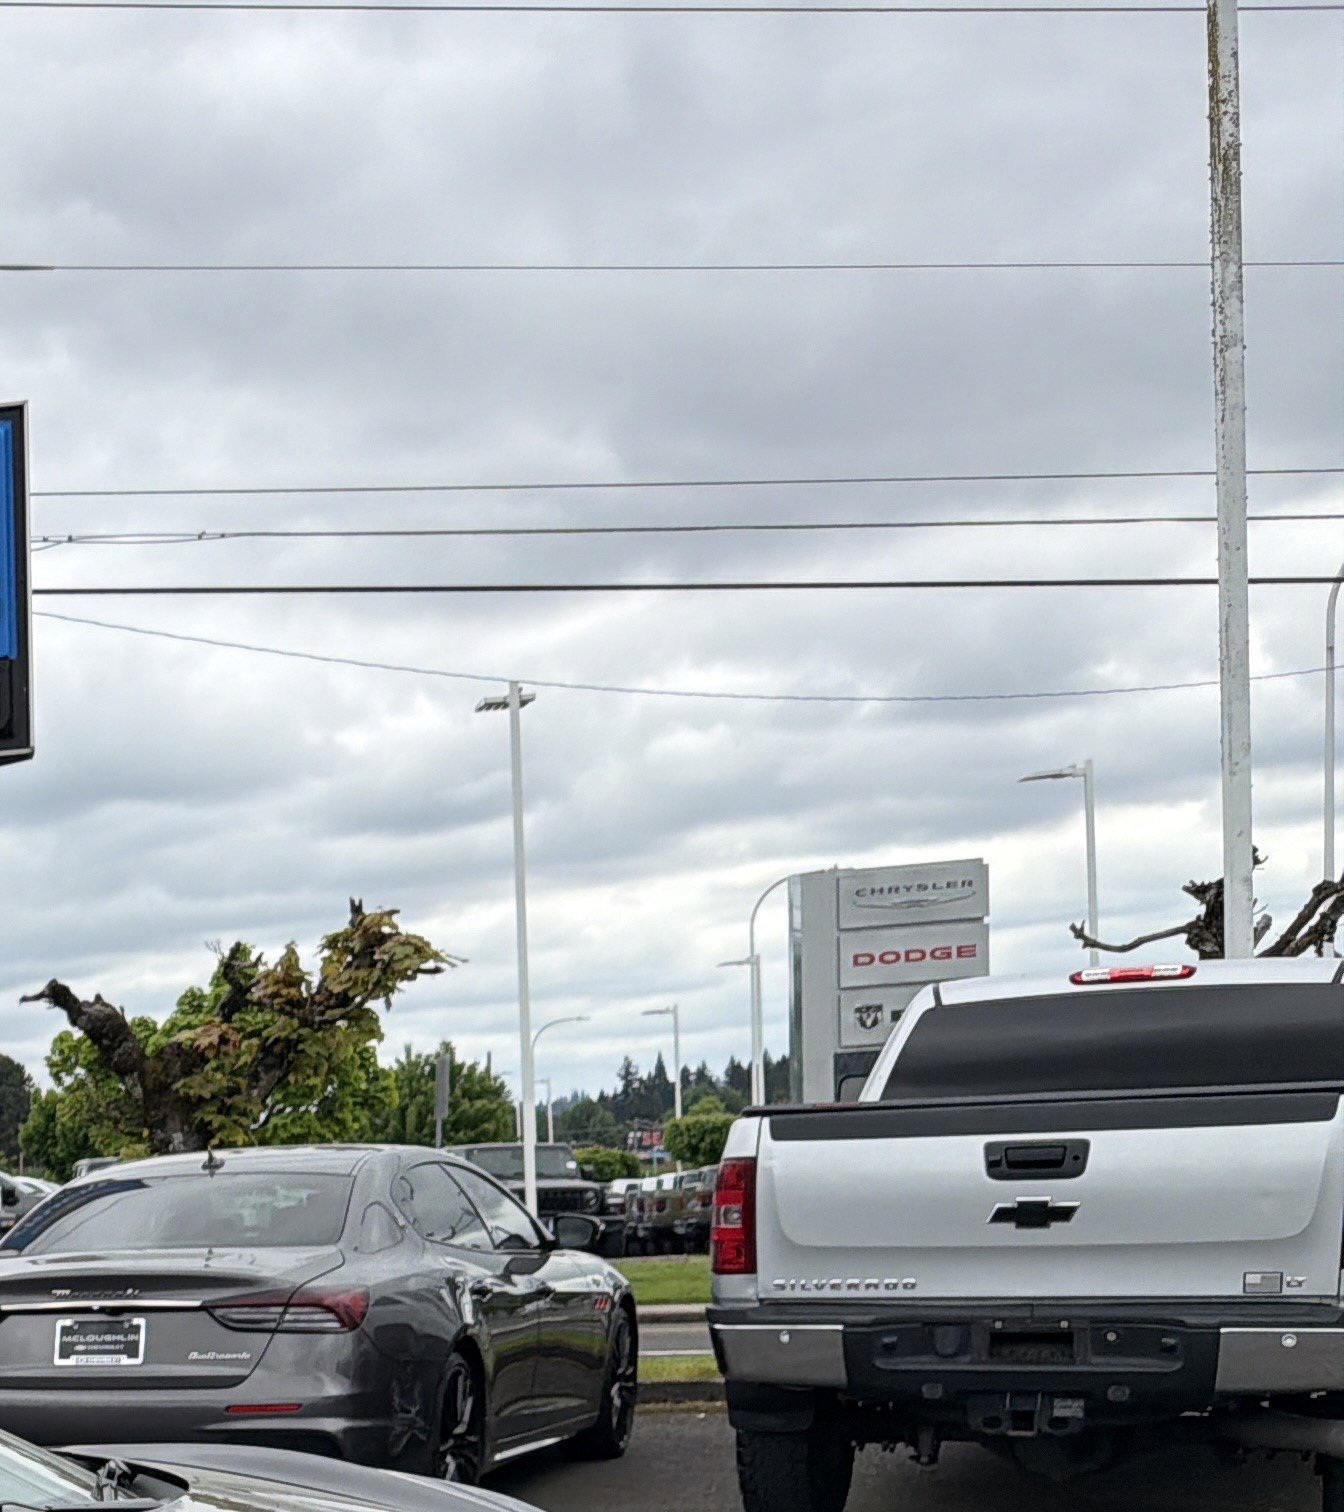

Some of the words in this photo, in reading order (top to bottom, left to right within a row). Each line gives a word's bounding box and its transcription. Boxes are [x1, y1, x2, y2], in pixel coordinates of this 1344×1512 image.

[855, 879, 974, 898] CHRYSLER
[852, 944, 977, 968] DODGE
[772, 1277, 917, 1292] SILVERADO
[1285, 1275, 1307, 1288] LT
